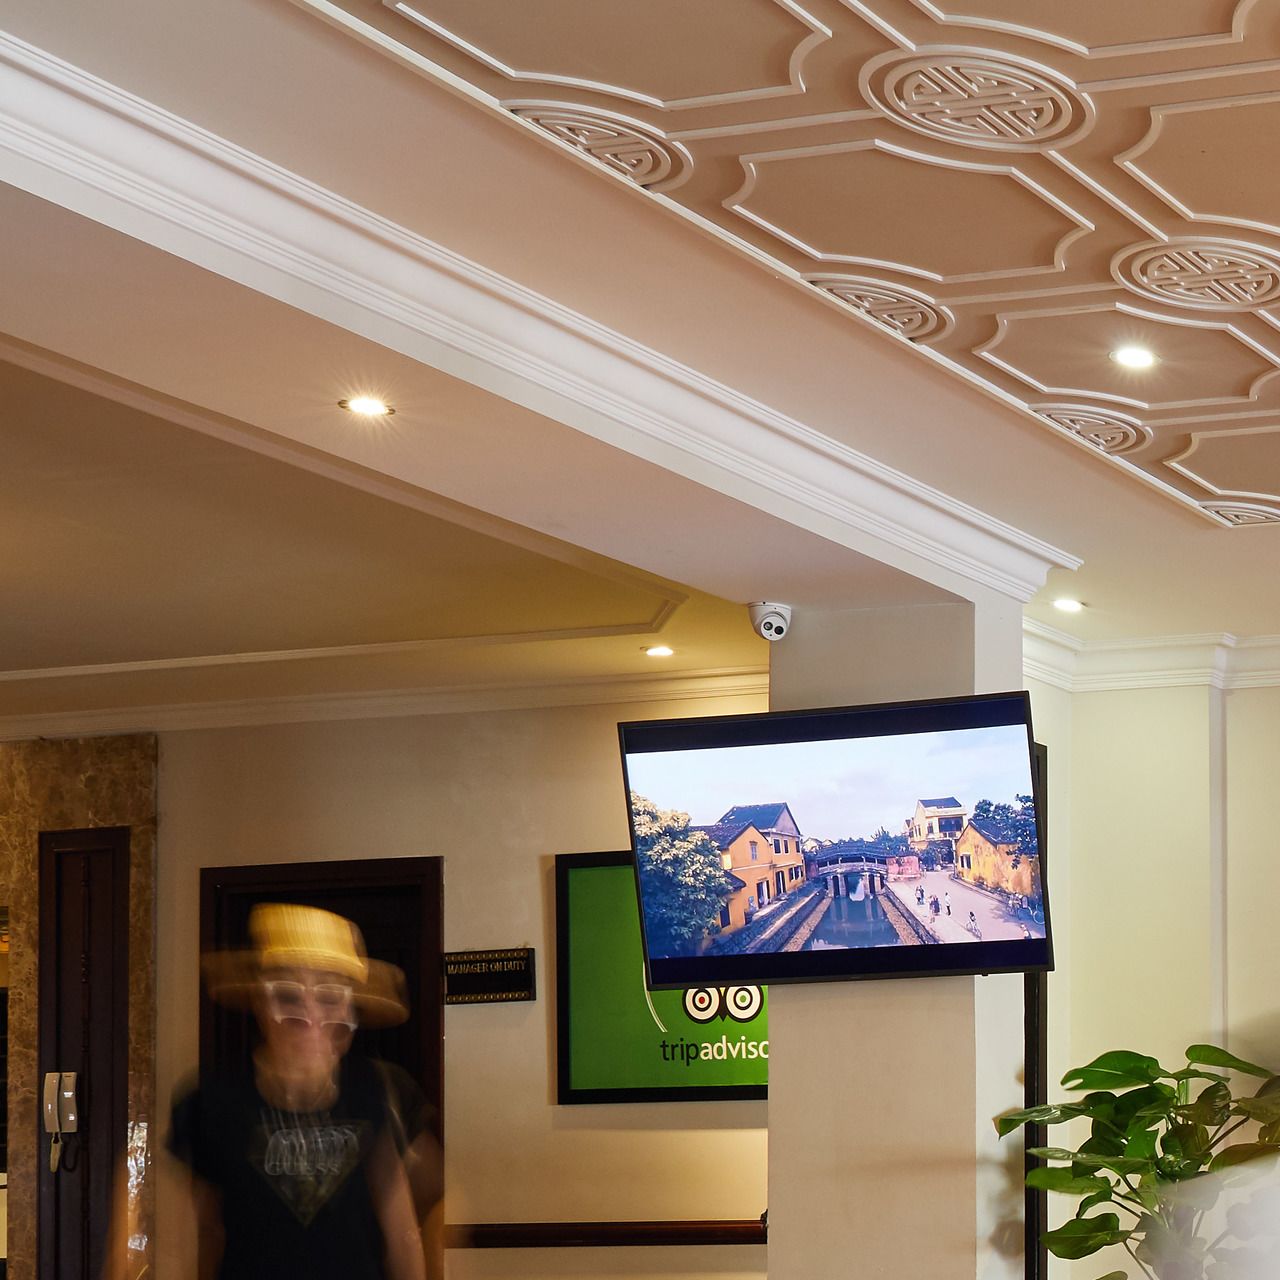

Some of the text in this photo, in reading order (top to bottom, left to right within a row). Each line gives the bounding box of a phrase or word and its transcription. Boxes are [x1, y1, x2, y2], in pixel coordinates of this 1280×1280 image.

[447, 959, 527, 975] MANAGER ON DUTY
